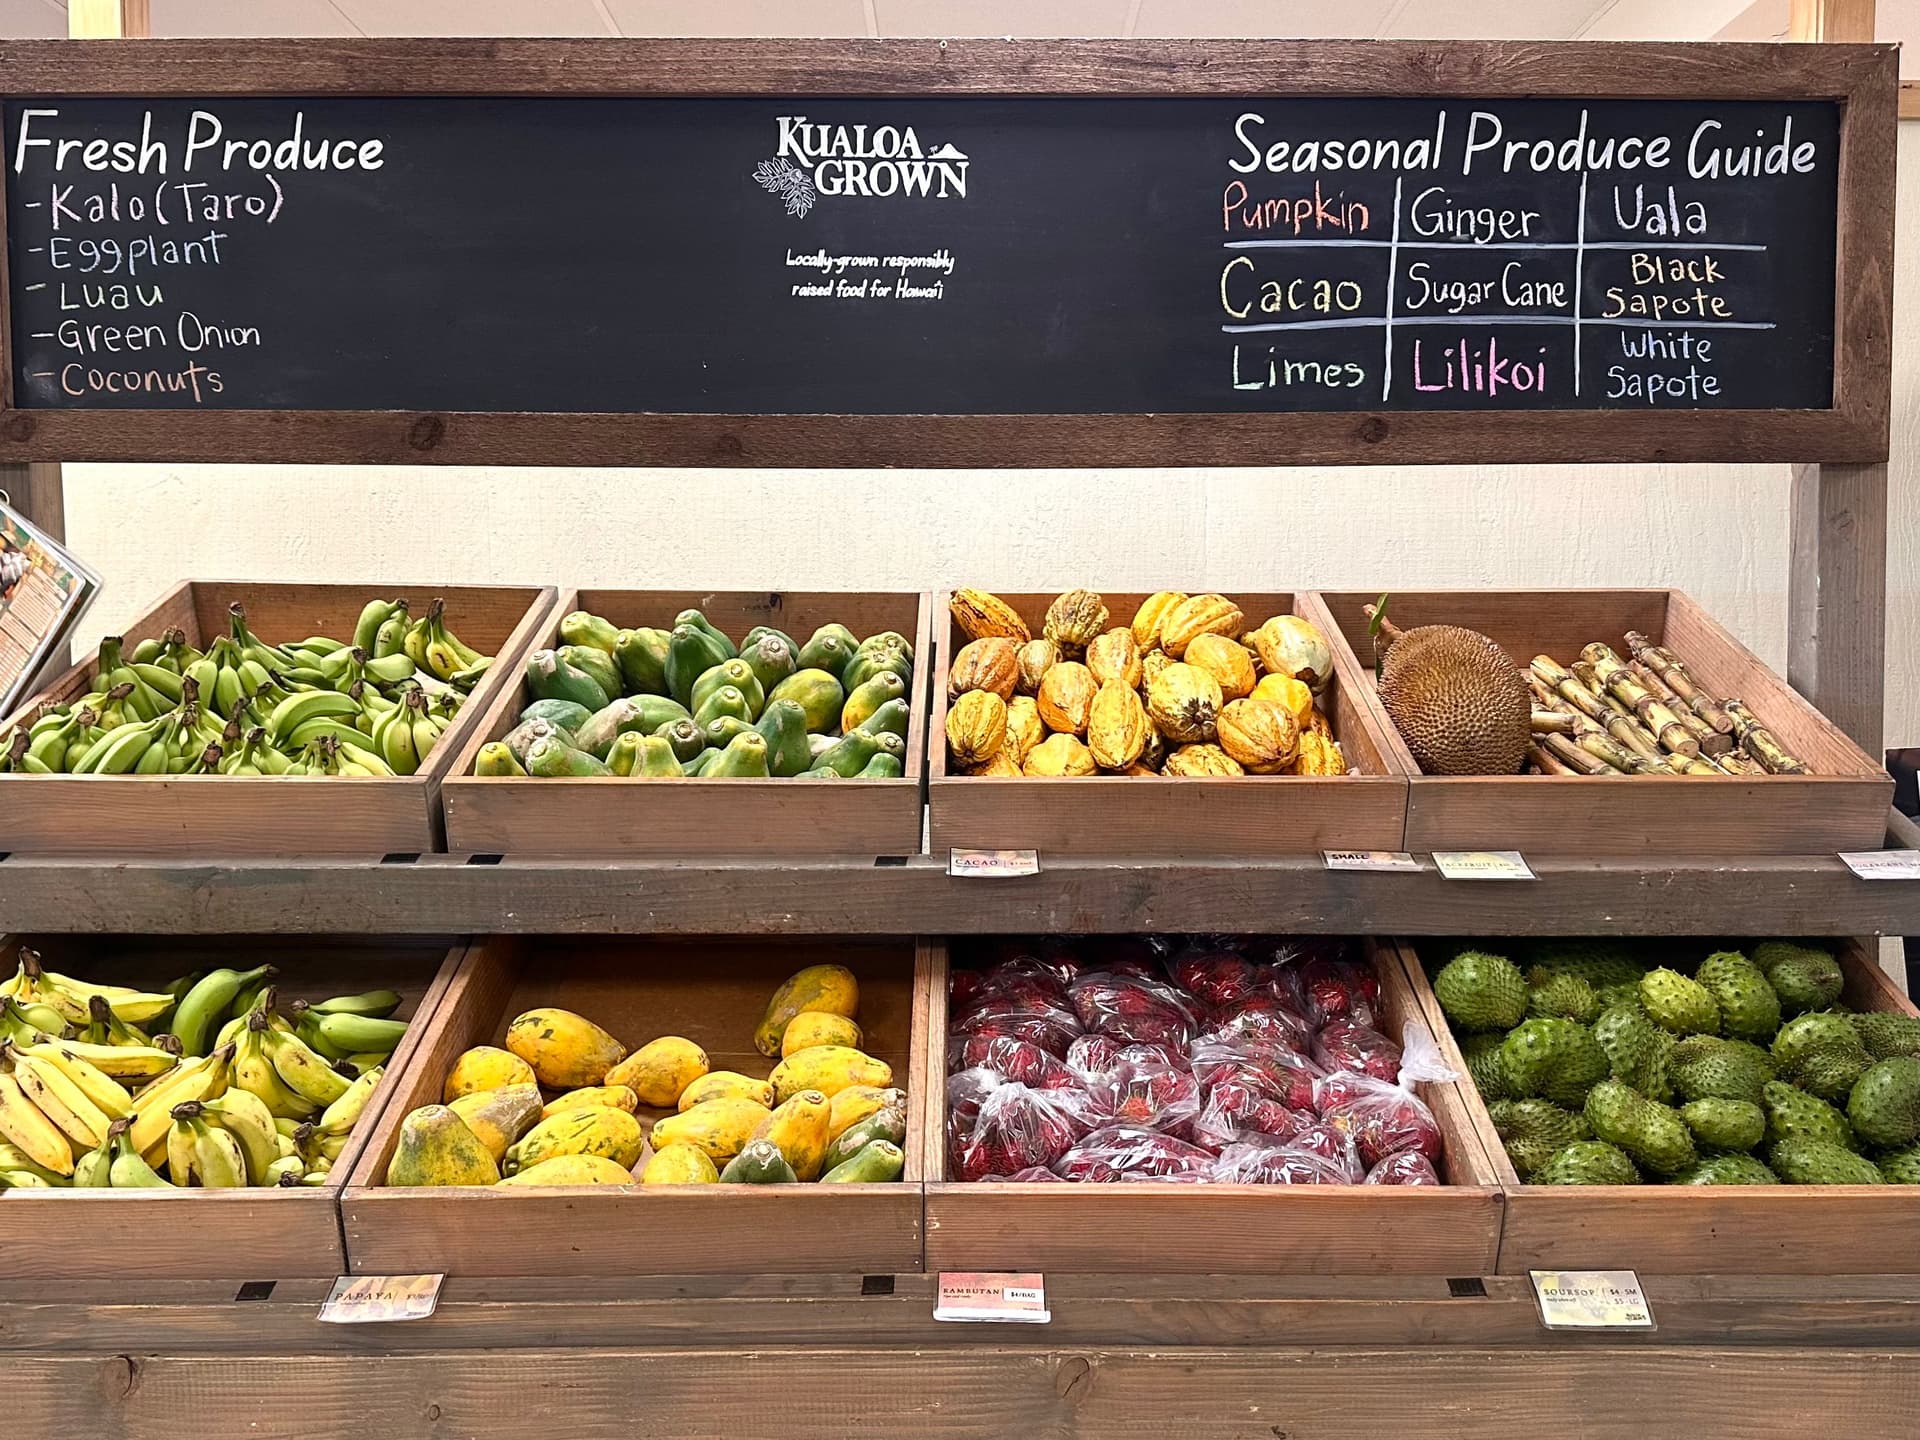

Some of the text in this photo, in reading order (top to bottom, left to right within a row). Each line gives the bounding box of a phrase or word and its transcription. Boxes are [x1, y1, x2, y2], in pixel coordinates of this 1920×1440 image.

[15, 109, 385, 174] Fresh Produce
[776, 117, 925, 167] KUALOA
[1228, 109, 1816, 180] Seasonal Produce Guide
[814, 160, 969, 198] GROWN
[1223, 180, 1369, 235] Pumpkin
[1411, 187, 1541, 243] Ginger
[1615, 184, 1707, 237] Uala
[786, 249, 955, 276] Locally-grown responsibly
[1631, 253, 1726, 284] Black
[792, 280, 834, 297] raised
[836, 279, 867, 298] food
[870, 279, 892, 297] for
[1221, 256, 1361, 318] Cacao
[1406, 262, 1568, 313] Sugar Cane
[1602, 287, 1733, 320] Sapote
[178, 312, 260, 351] Onion
[1622, 330, 1711, 362] White
[1233, 345, 1365, 391] Limes
[1414, 337, 1546, 395] Lilikoi
[1607, 365, 1721, 404] Sapote
[335, 1292, 393, 1300] PAPAYA
[943, 1287, 1000, 1295] RAMBUTAN
[1543, 1288, 1595, 1296] SOURSOP
